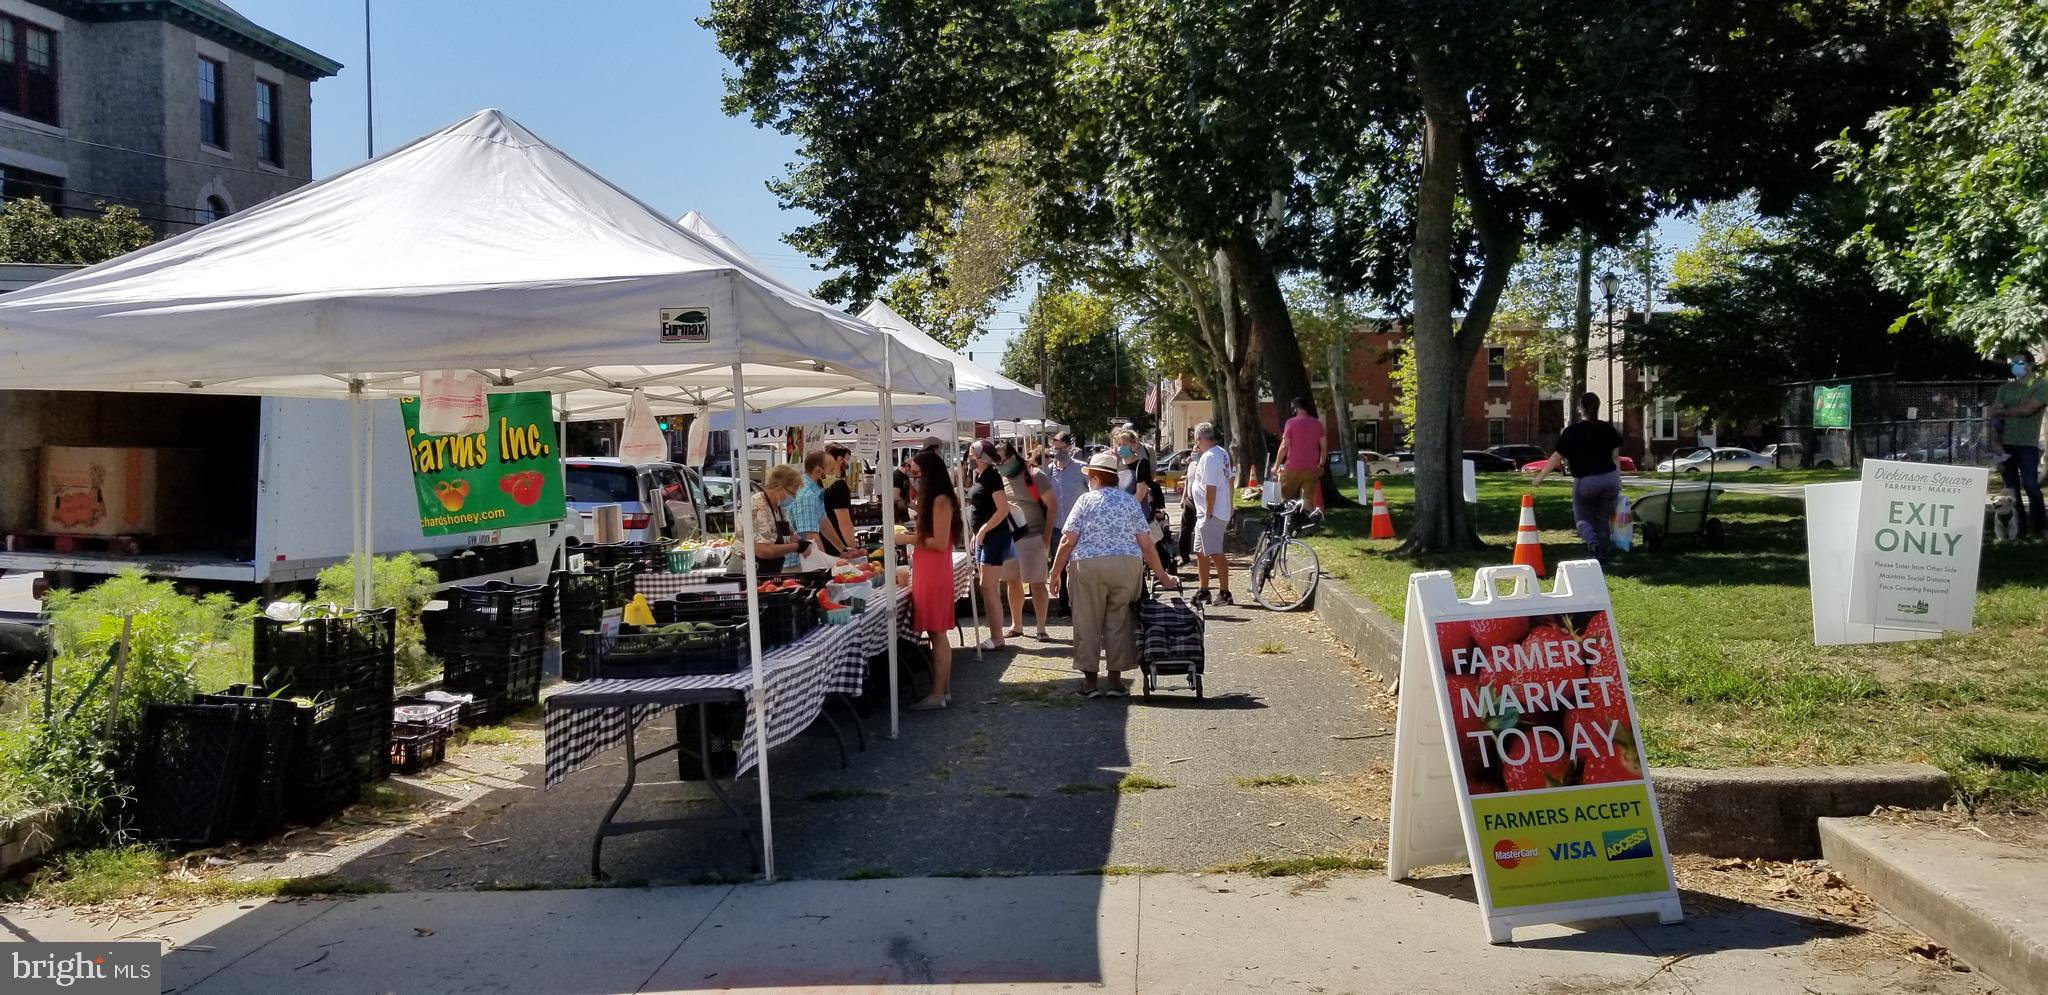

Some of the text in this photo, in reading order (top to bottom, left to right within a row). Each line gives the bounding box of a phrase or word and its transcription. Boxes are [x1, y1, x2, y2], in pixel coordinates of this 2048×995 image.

[662, 322, 705, 338] Eurmax
[500, 416, 550, 462] Inc.
[1874, 467, 1973, 487] Dickinson Square
[1884, 482, 1961, 494] FARMERS' MARKET
[1888, 500, 1955, 528] EXIT
[1874, 528, 1963, 557] ONLY
[1874, 561, 1894, 569] Please
[1895, 562, 1910, 570] Enter
[1926, 564, 1943, 572] Other
[1907, 574, 1926, 582] Social
[1926, 575, 1951, 583] Distance
[1879, 583, 1949, 595] Face Covering Required
[1451, 636, 1606, 676] FARMERS'
[1459, 676, 1614, 719] MARKET
[1466, 719, 1619, 769] TODAY
[1483, 800, 1642, 831] FARMERS ACCEPT
[1495, 829, 1648, 862] MasterCard VISA ACCESS
